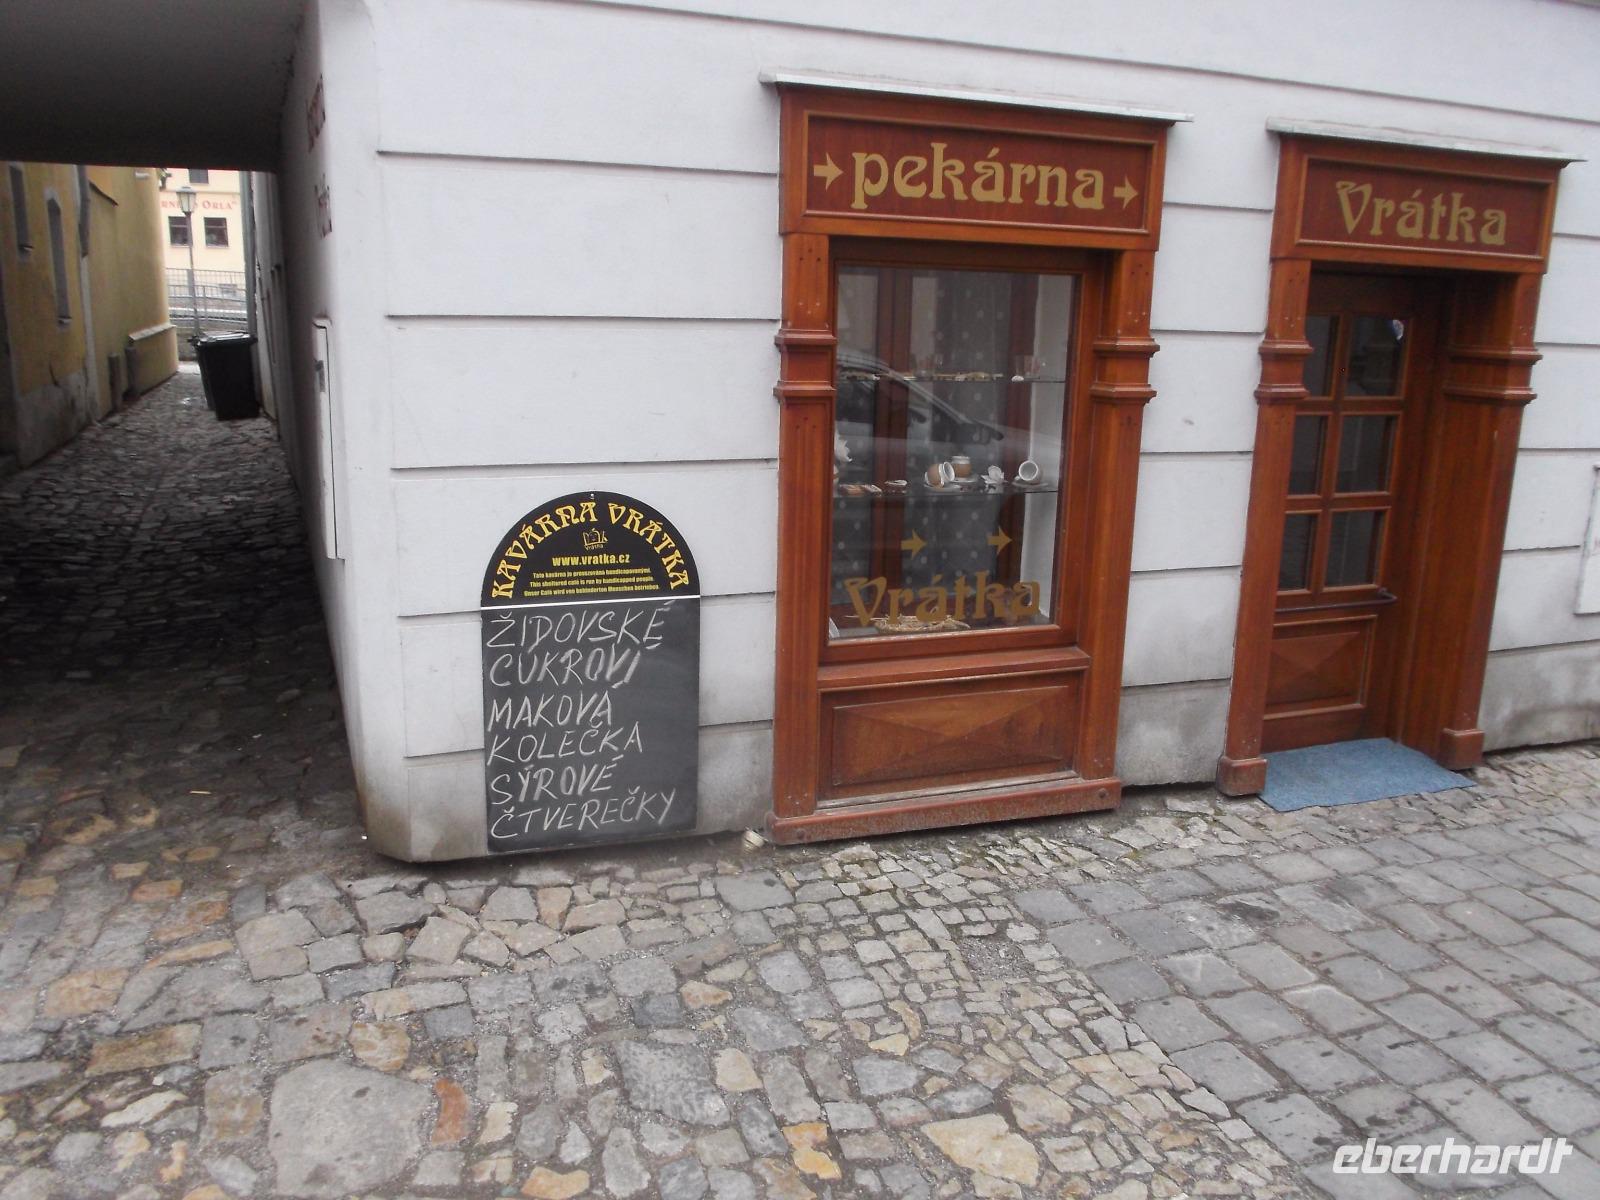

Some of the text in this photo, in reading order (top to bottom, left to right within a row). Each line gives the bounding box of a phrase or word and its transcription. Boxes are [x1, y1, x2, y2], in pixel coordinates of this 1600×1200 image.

[851, 142, 1104, 210] pekárna
[1336, 180, 1506, 245] Vrátka
[491, 501, 690, 599] KAVÁRNA VRÁTKA
[552, 553, 630, 567] www.vratka.cz
[844, 570, 1040, 627] Vrátka
[486, 600, 676, 653] ŽIDOVSKÉ
[491, 754, 624, 805] SÝROVÉ
[491, 785, 676, 839] ČTVEREČKY
